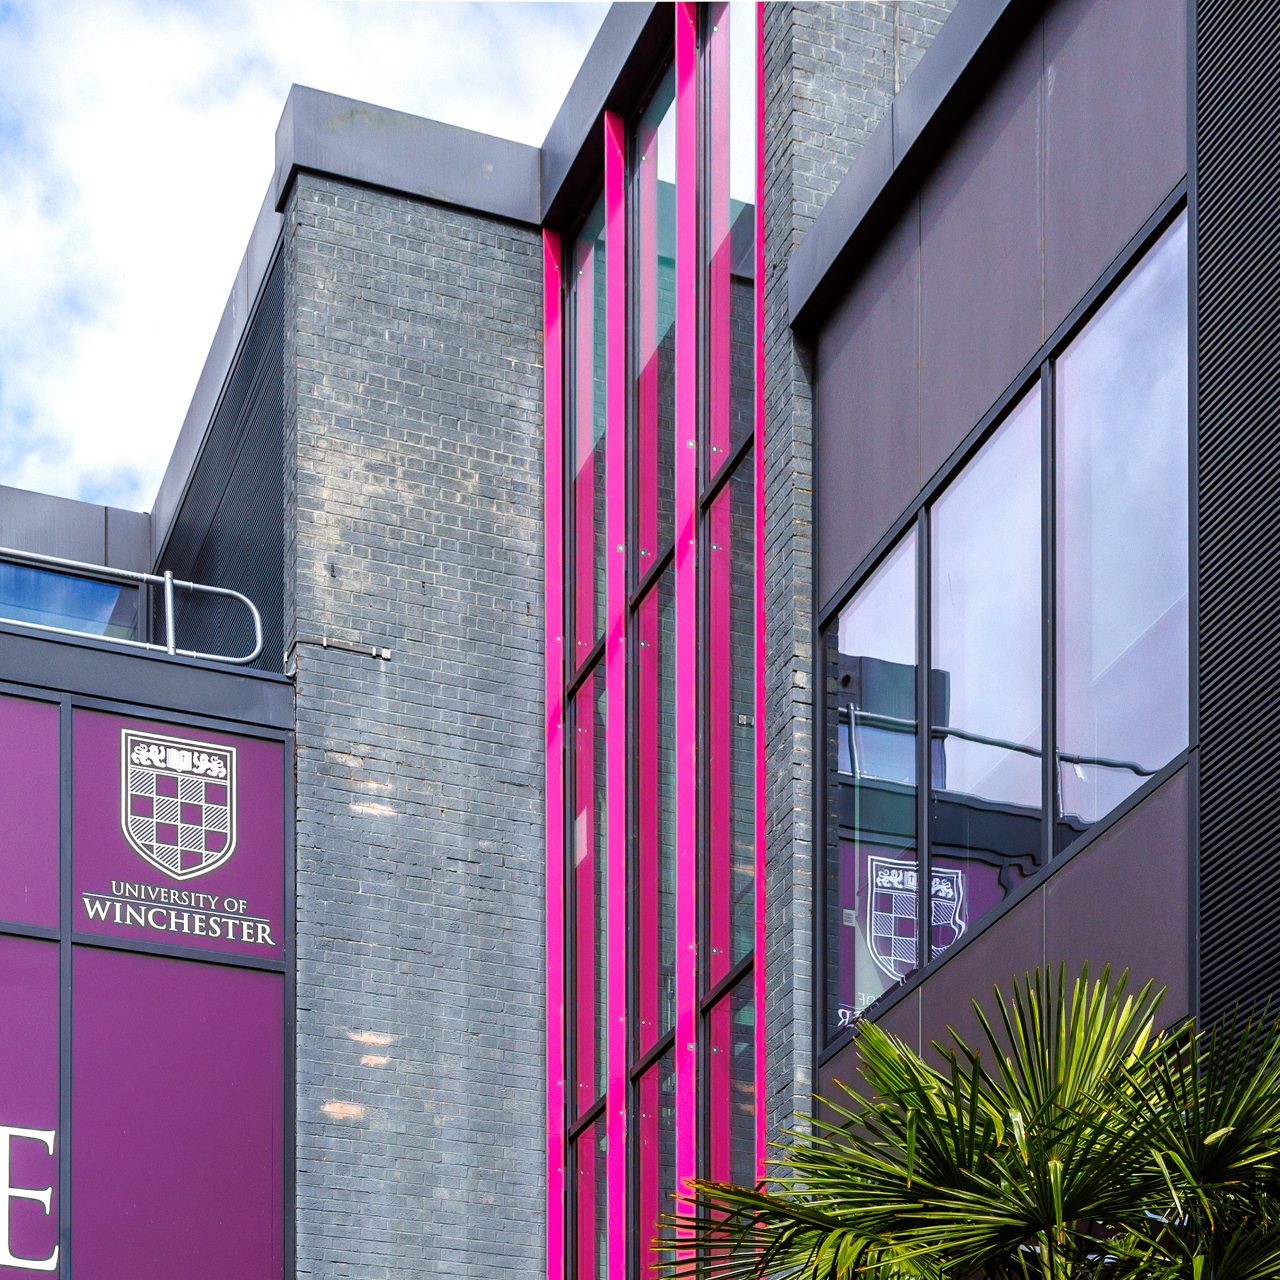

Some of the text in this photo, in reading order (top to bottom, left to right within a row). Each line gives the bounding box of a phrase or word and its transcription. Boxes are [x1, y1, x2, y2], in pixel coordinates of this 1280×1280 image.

[111, 880, 247, 914] UNIVERSITY OF
[82, 897, 276, 946] WINCHESTER
